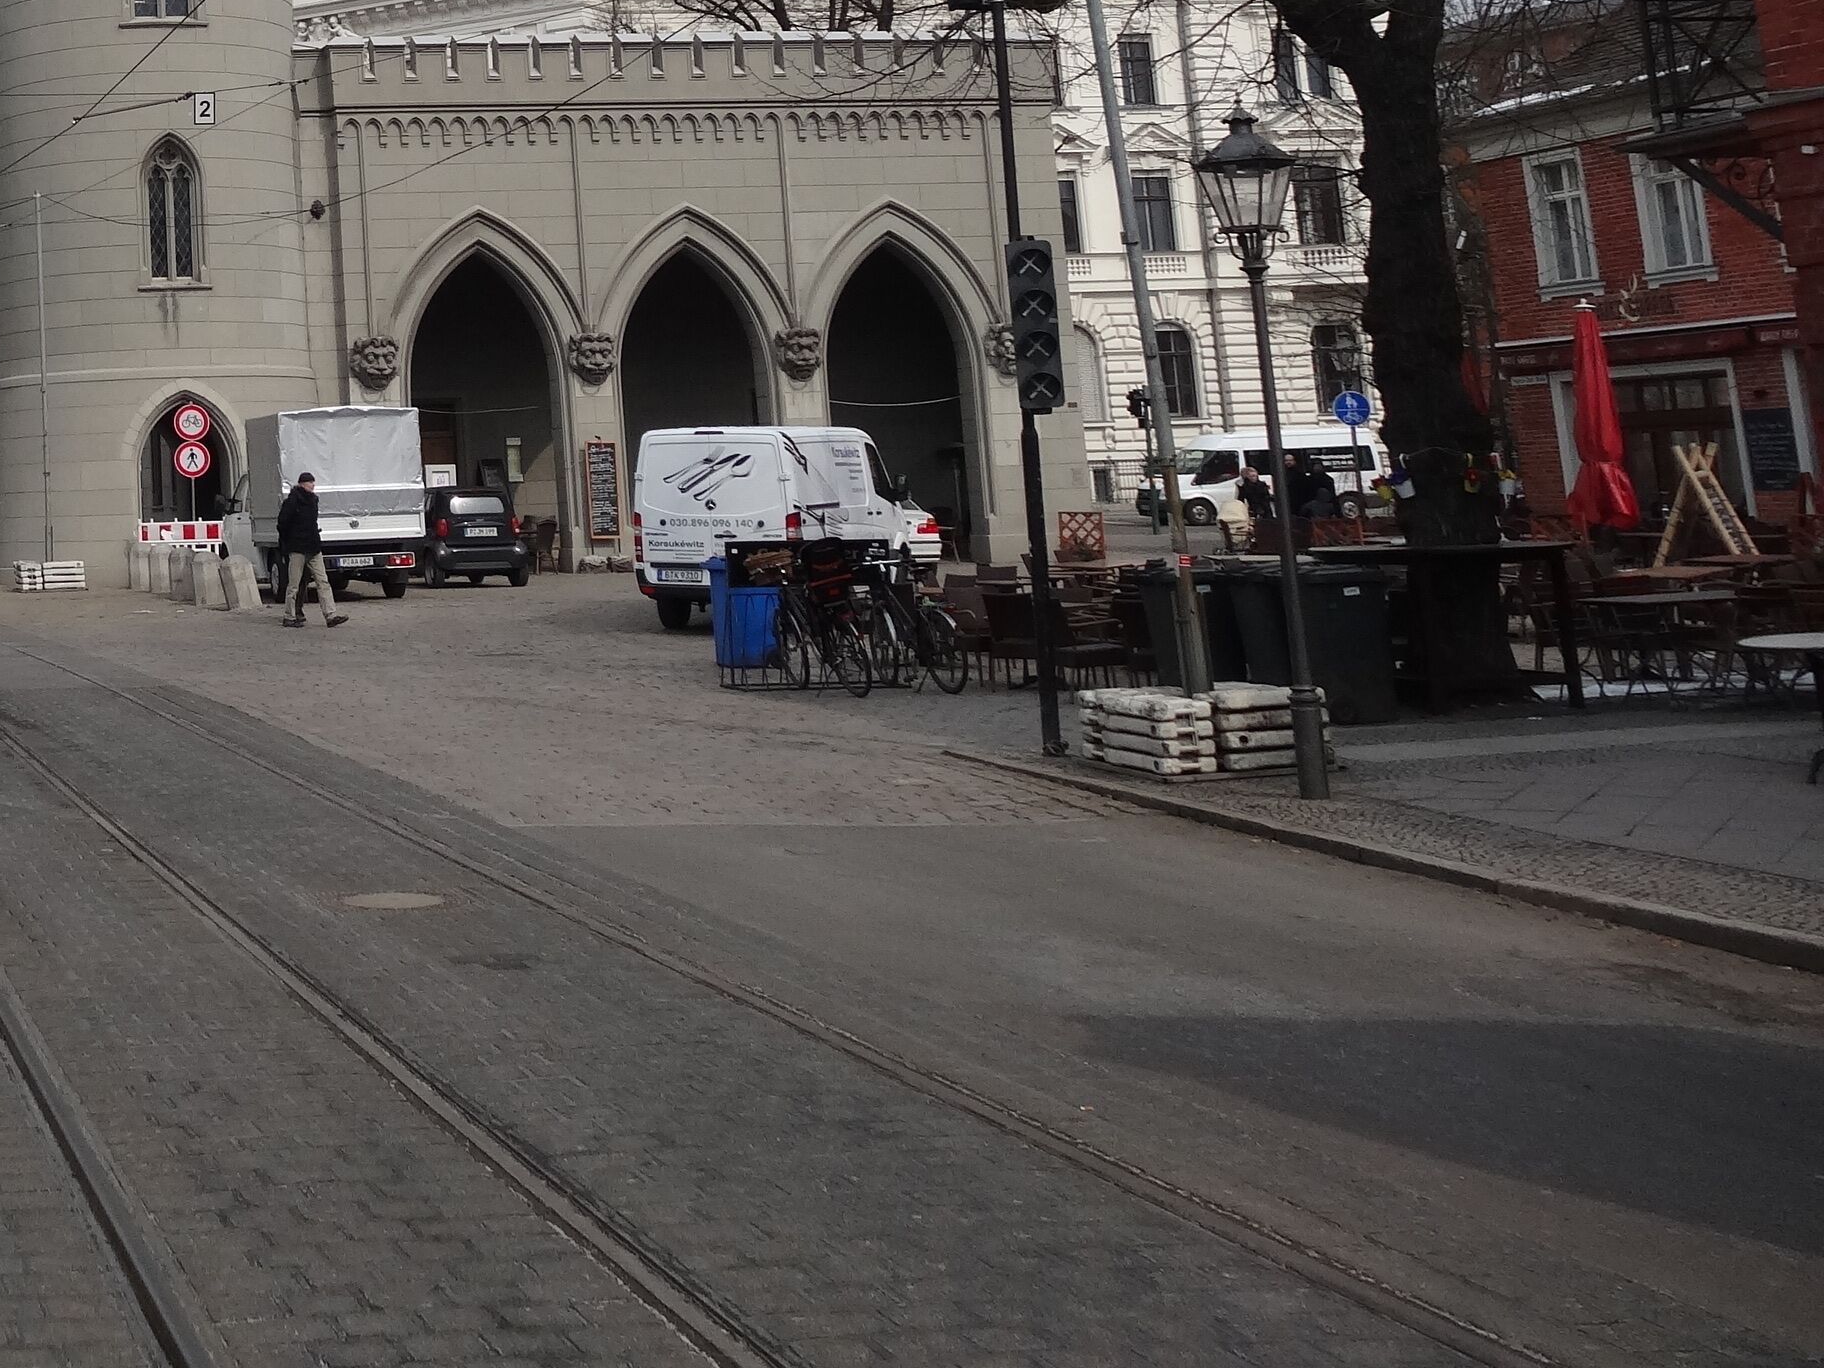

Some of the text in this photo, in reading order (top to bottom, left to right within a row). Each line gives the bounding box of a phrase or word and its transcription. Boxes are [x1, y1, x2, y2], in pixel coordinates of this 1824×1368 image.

[199, 100, 211, 118] 2
[669, 518, 753, 528] 030.896 096 140
